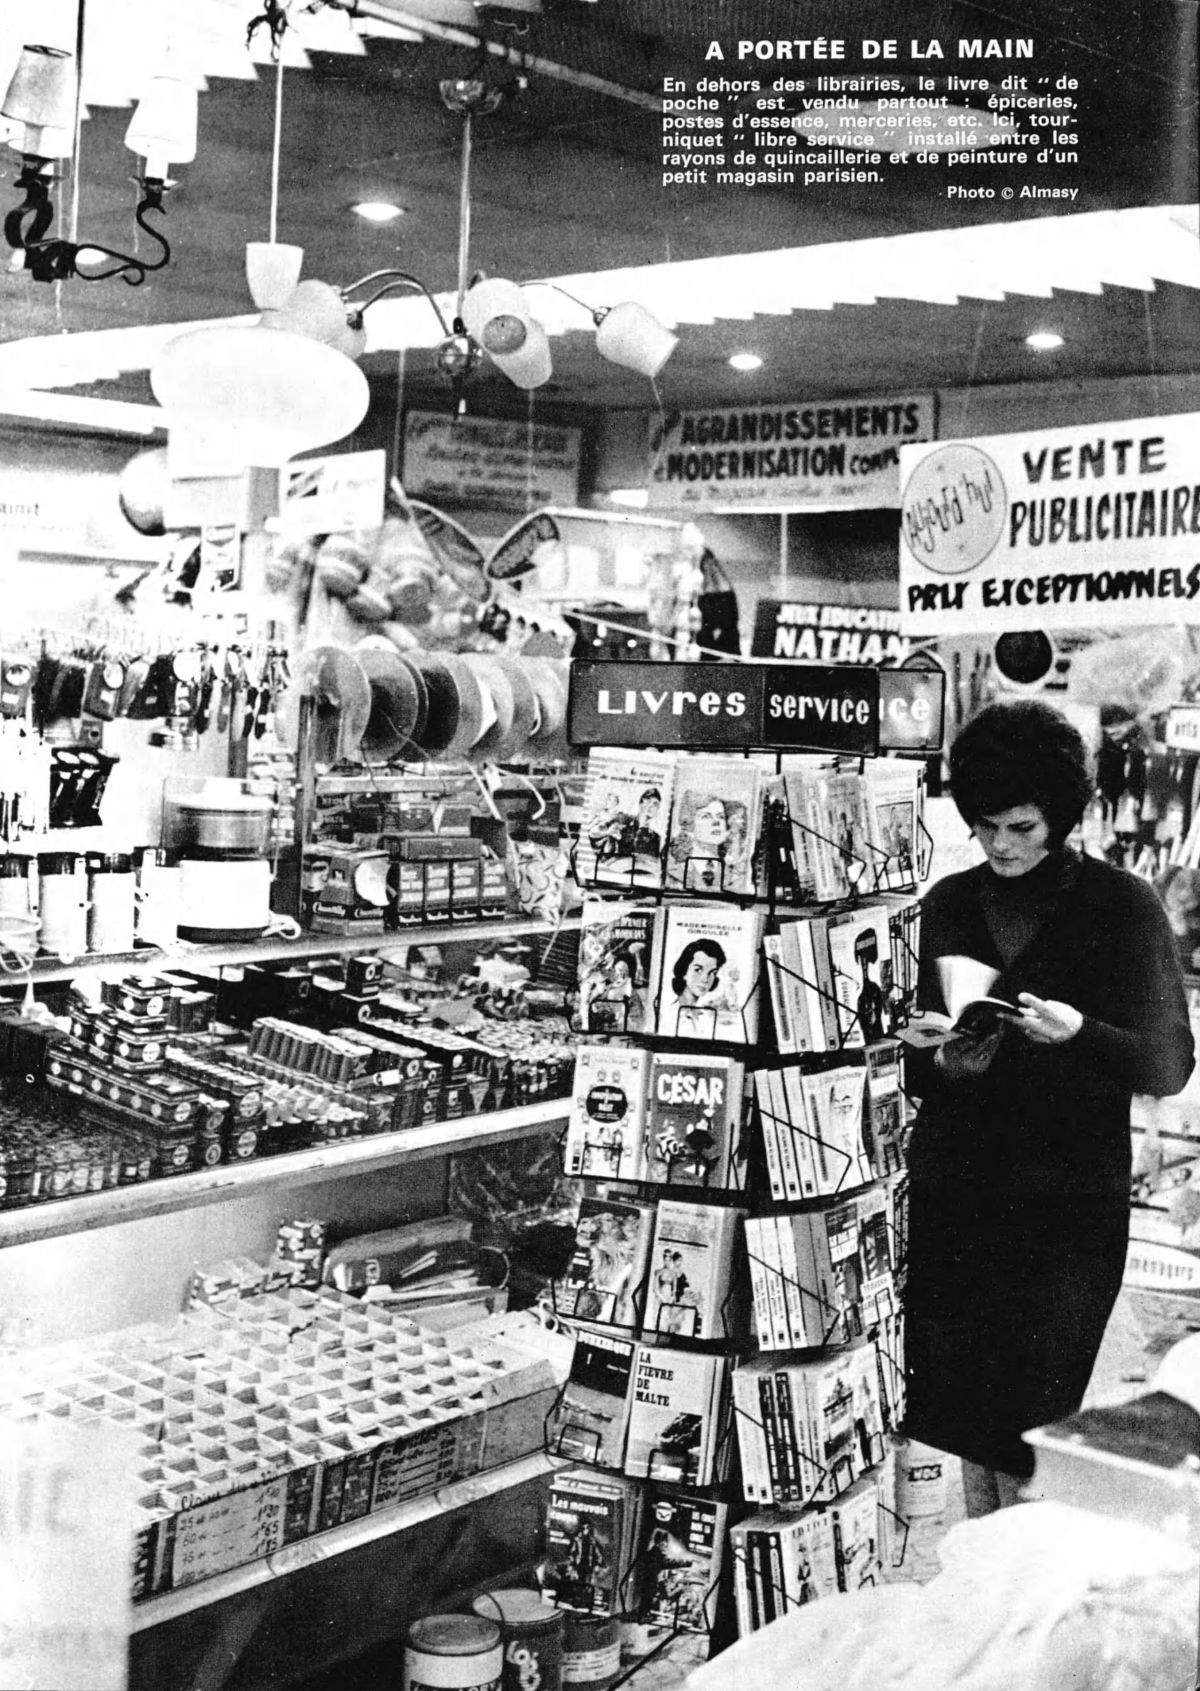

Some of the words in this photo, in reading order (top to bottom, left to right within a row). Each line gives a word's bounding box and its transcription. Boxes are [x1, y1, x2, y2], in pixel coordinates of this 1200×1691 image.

[667, 444, 846, 482] MODERNISATION
[1022, 436, 1168, 485] VENTE
[774, 626, 912, 668] NATHAN
[640, 1351, 652, 1364] LA
[636, 1377, 651, 1390] DE
[635, 1391, 671, 1407] MALTE
